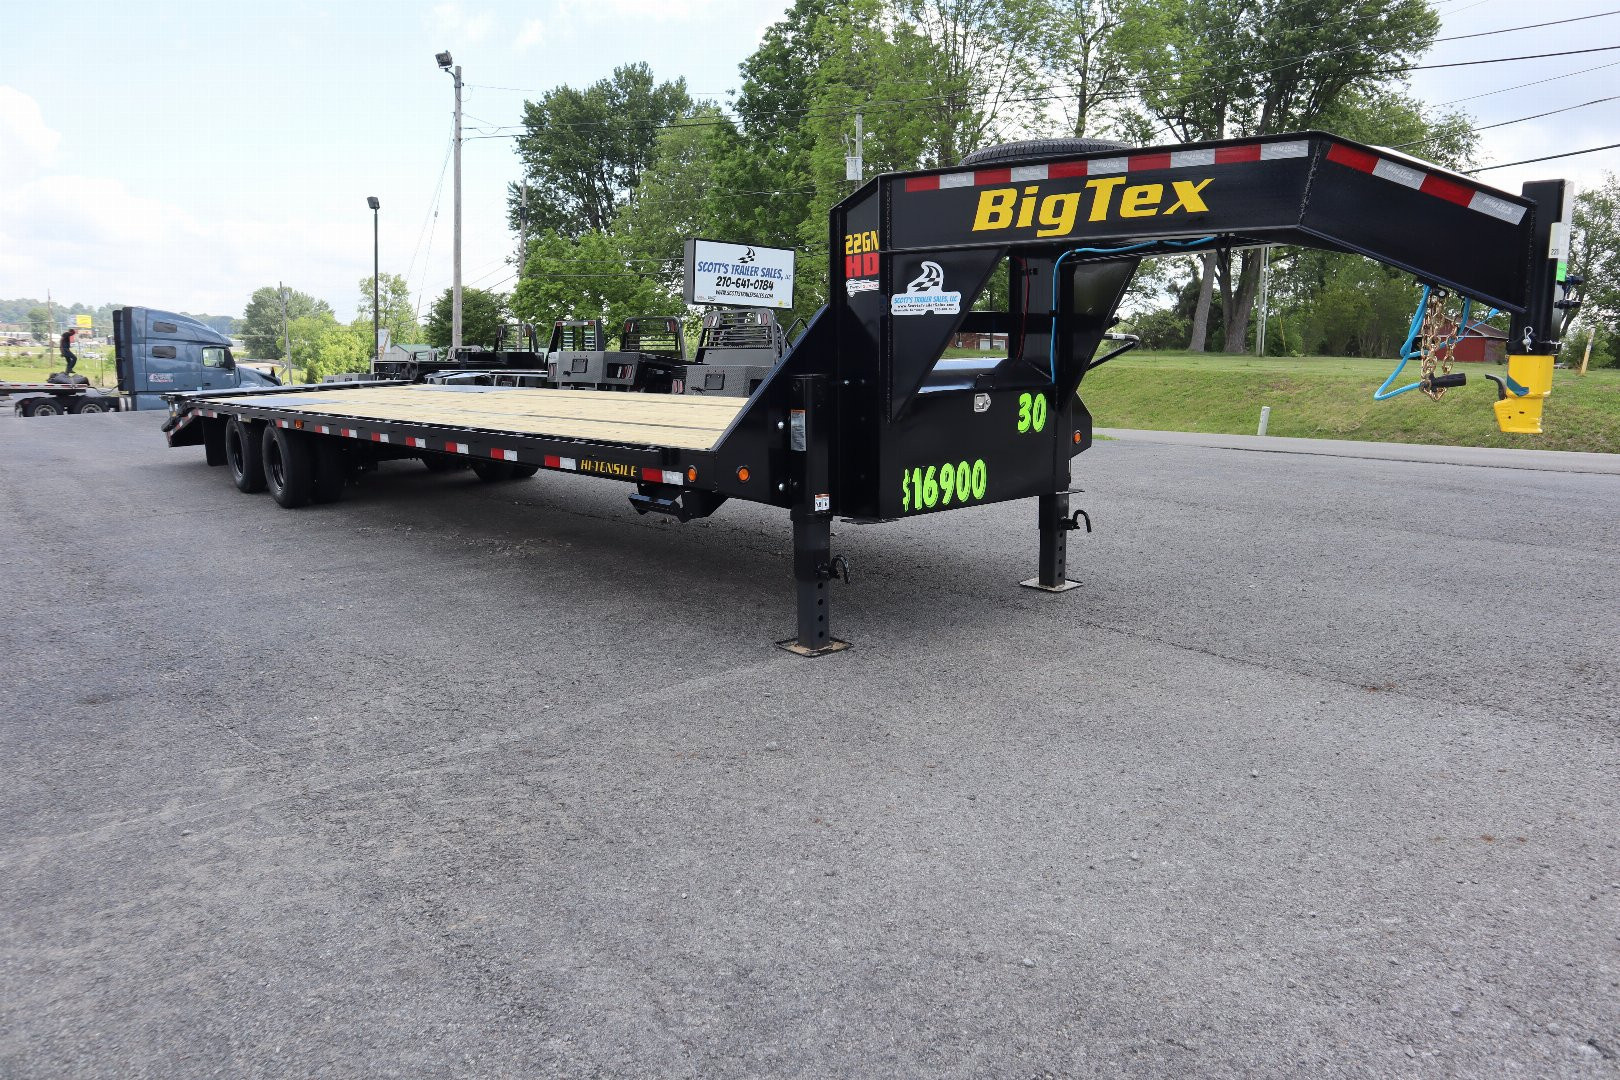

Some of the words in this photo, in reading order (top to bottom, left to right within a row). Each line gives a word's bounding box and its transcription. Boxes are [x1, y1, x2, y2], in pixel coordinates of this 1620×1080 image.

[971, 176, 1215, 238] BigTex
[697, 261, 729, 275] SCOTT'S
[731, 264, 760, 277] TRAILER
[760, 267, 784, 280] SALES,
[845, 252, 879, 278] HD
[715, 276, 774, 291] 270-641-0784
[1017, 392, 1047, 433] 30
[580, 459, 638, 477] HI-TENSILE
[902, 459, 987, 513] $16900
